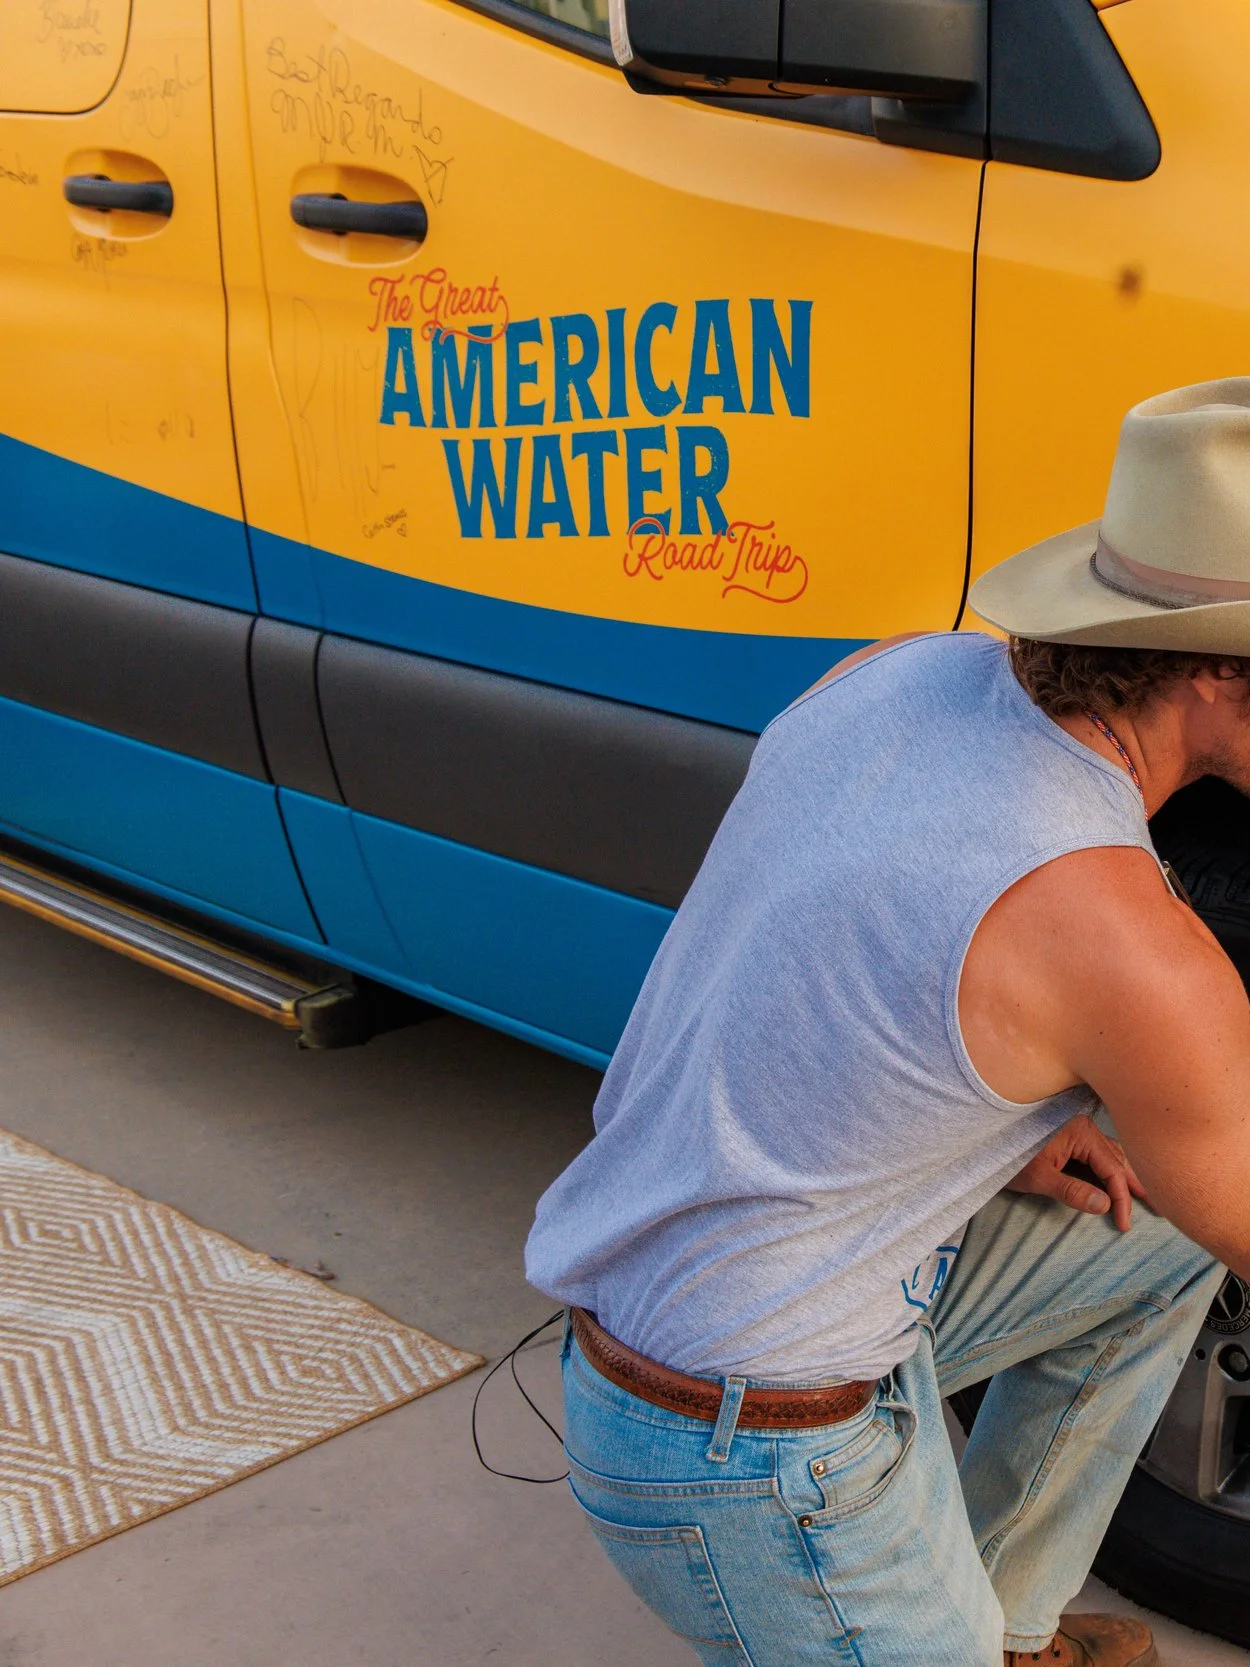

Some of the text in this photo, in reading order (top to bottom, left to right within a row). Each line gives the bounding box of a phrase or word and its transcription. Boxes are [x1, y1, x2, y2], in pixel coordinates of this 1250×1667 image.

[368, 267, 509, 345] The Great
[379, 297, 814, 428] AMERICAN
[441, 424, 736, 539] WATER
[623, 517, 809, 602] Road Trip
